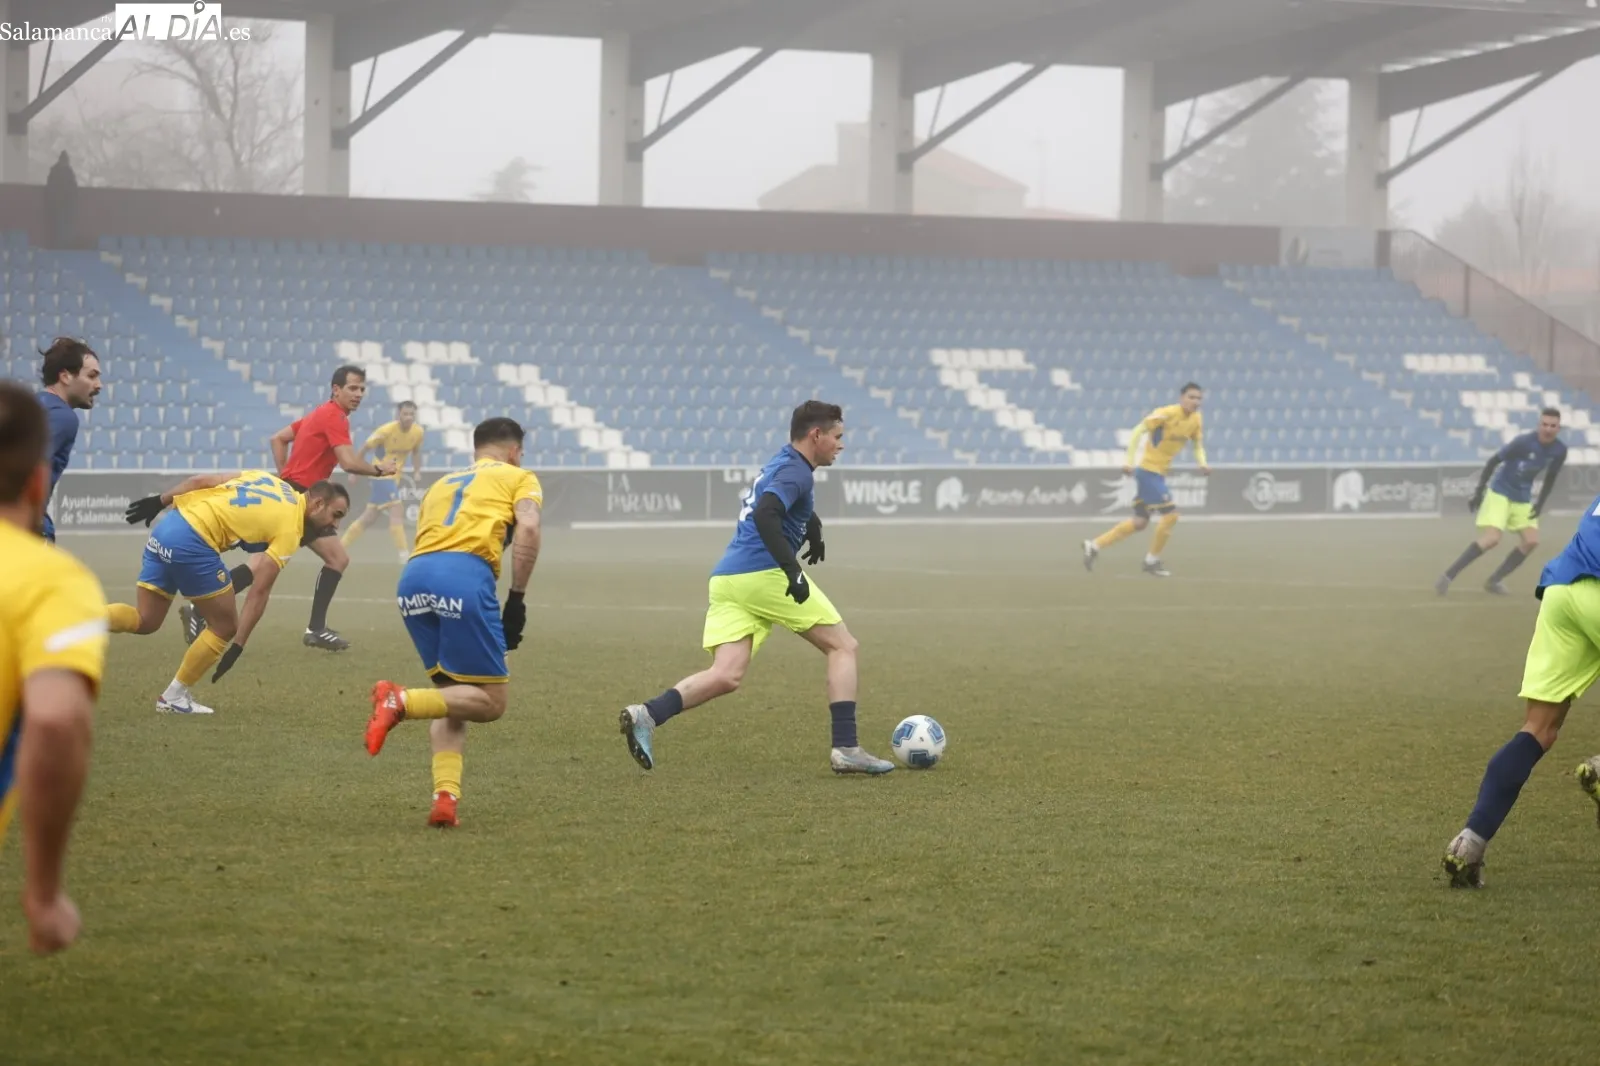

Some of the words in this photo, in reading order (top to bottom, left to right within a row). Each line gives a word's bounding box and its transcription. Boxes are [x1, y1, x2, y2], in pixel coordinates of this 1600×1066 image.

[61, 495, 131, 511] Ayuntamiento
[443, 472, 478, 527] 7
[61, 511, 74, 525] de
